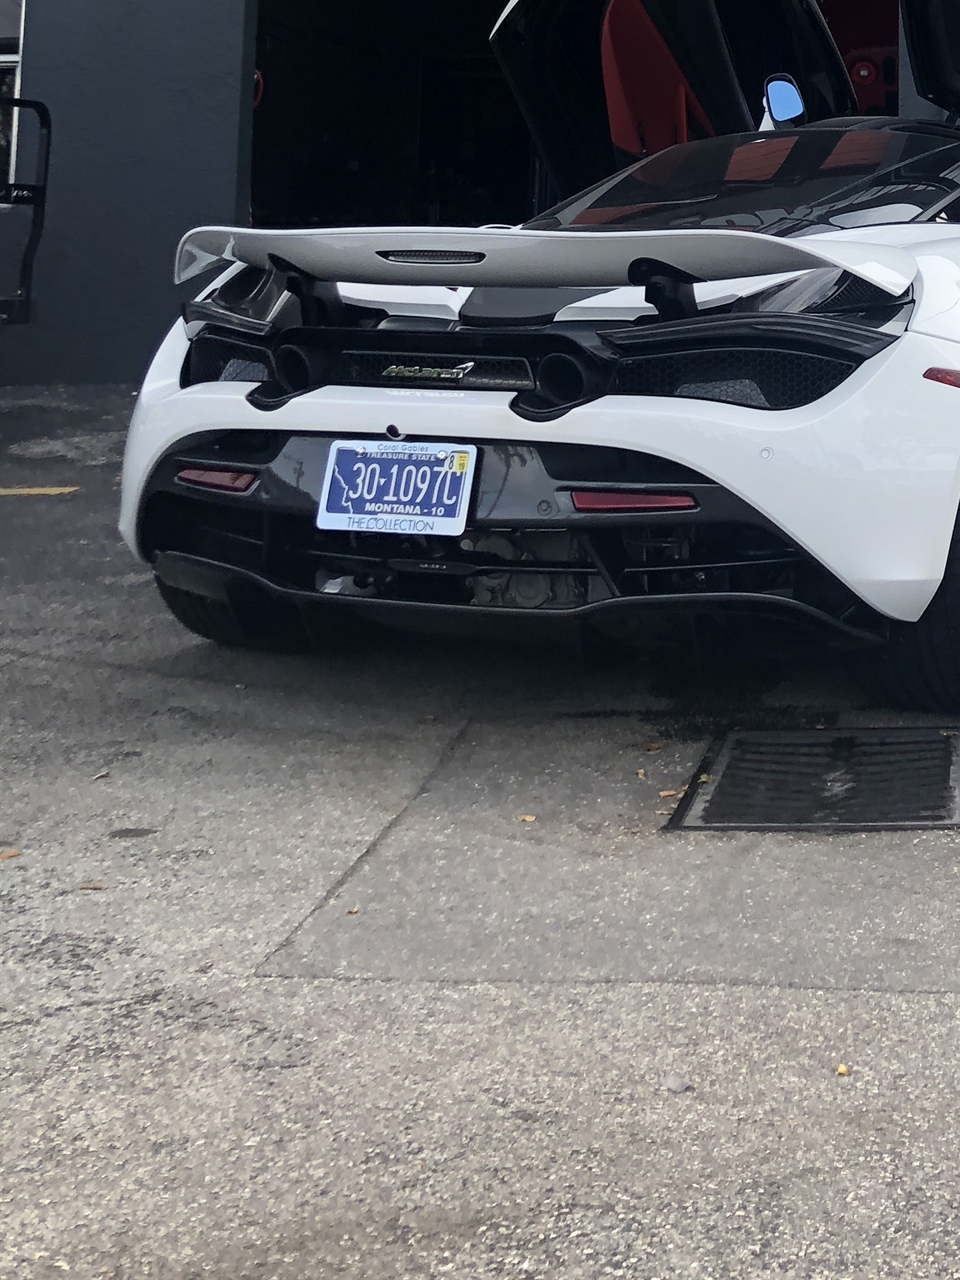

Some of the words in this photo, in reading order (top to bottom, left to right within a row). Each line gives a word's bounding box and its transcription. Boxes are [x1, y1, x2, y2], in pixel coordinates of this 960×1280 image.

[381, 365, 464, 378] McLaren
[377, 443, 399, 452] Coral
[401, 444, 429, 453] Gables
[366, 452, 409, 460] TREASURE
[411, 453, 436, 462] STATE
[364, 502, 422, 515] MONTANA
[431, 507, 445, 516] 10
[347, 516, 366, 529] THE
[365, 517, 435, 532] COLLECTION
